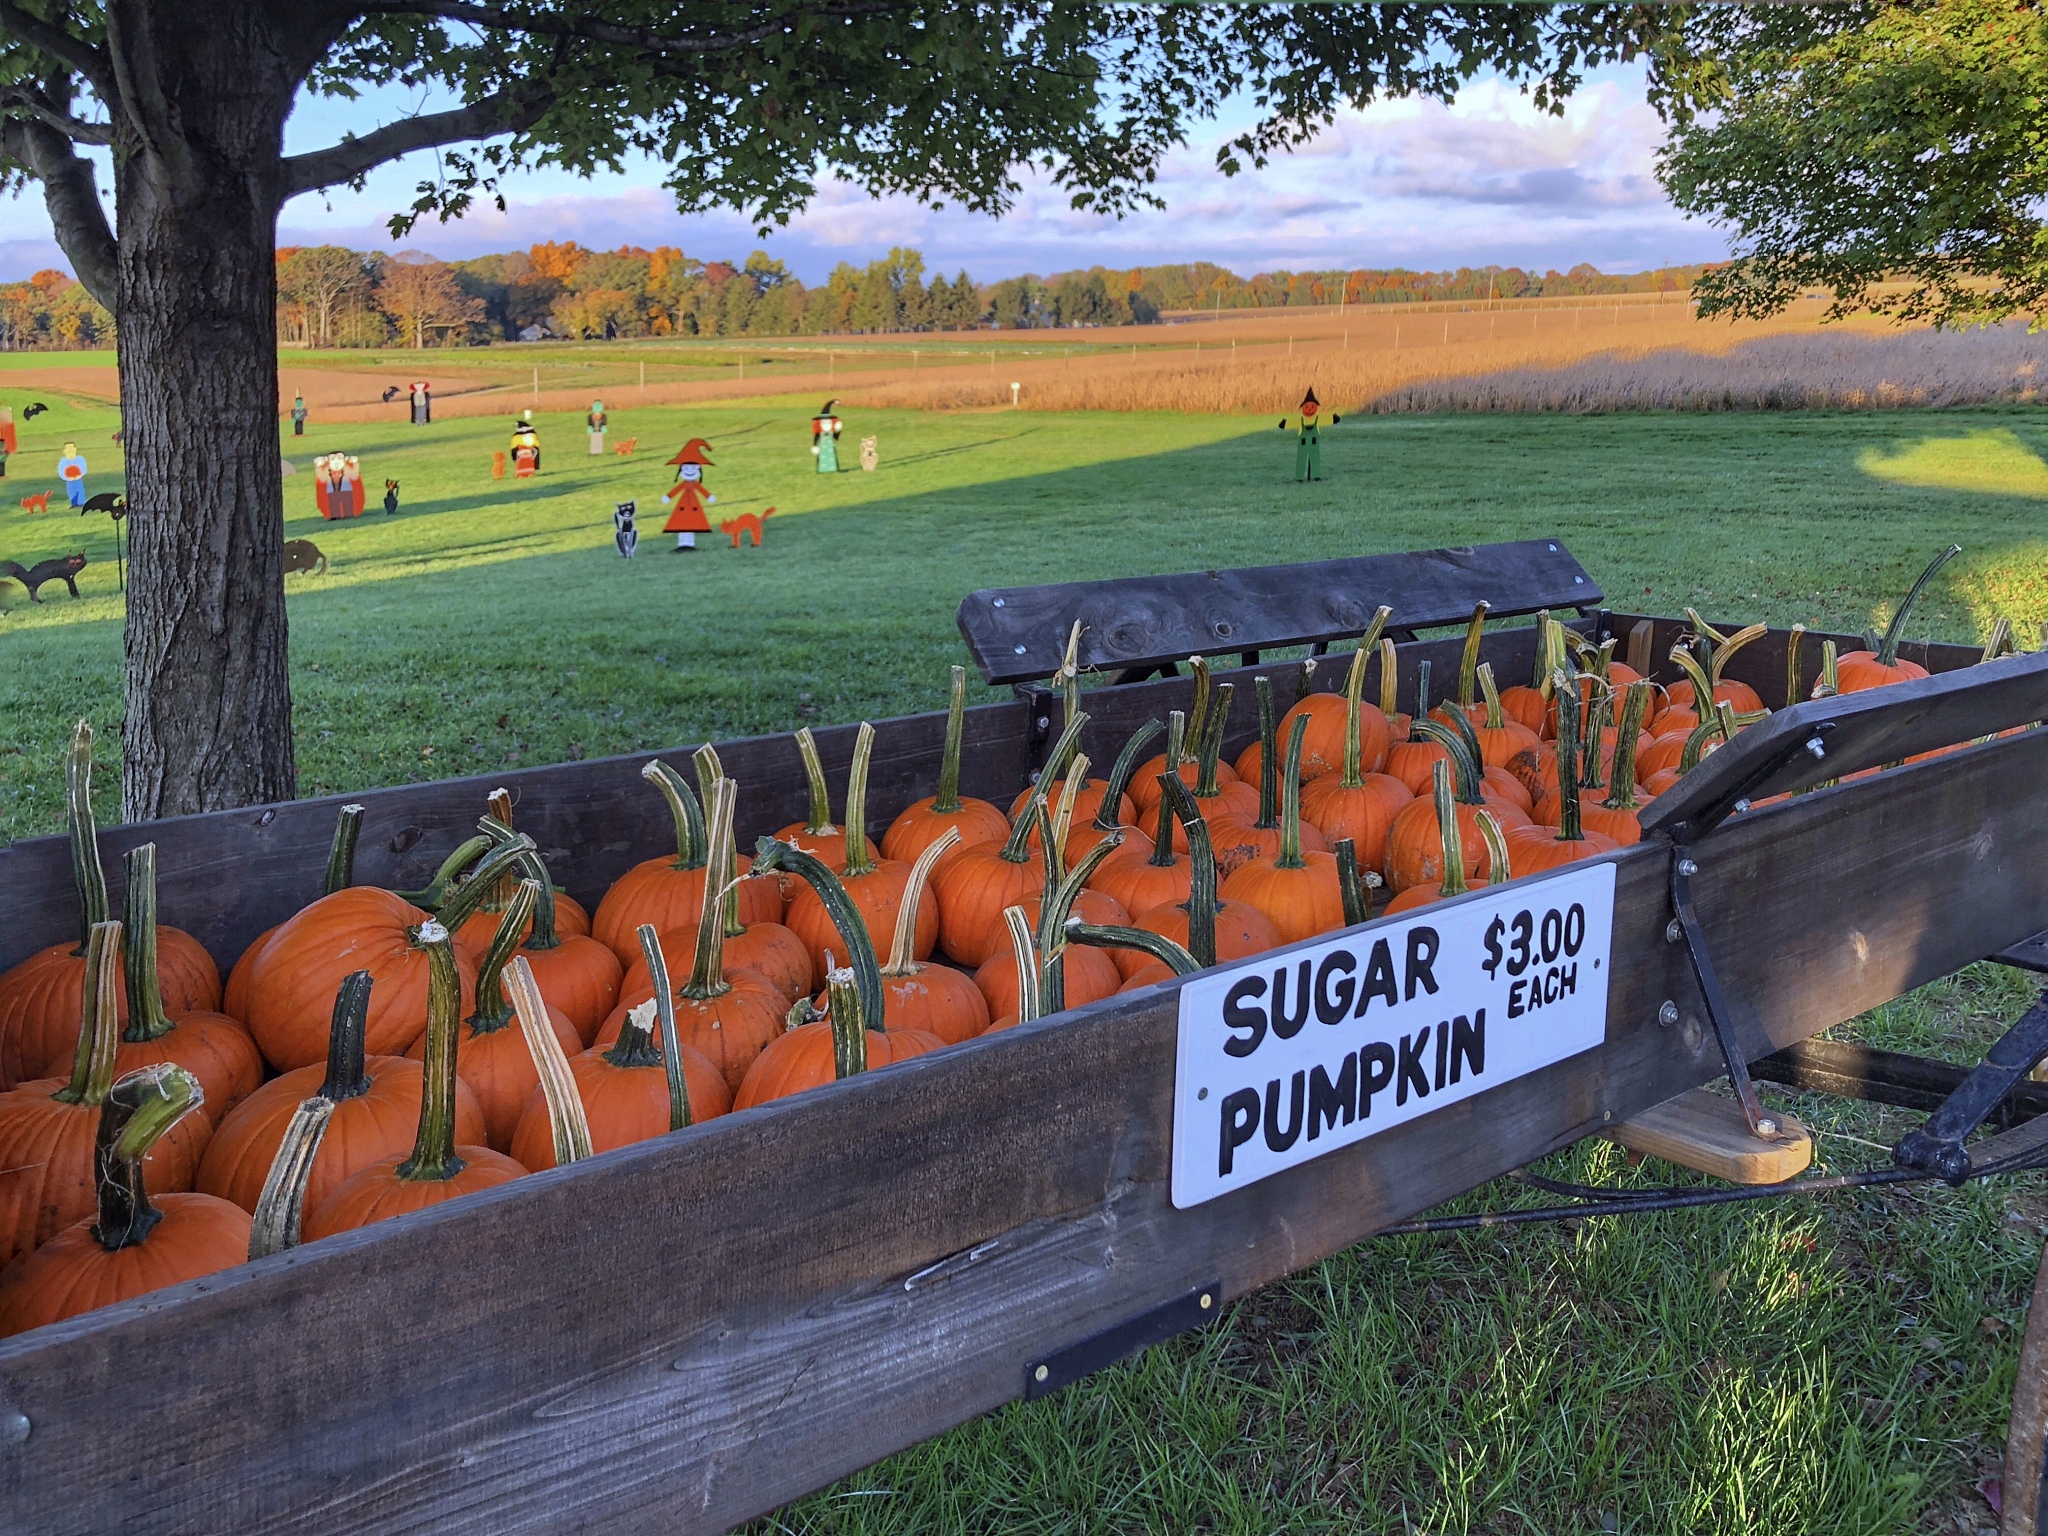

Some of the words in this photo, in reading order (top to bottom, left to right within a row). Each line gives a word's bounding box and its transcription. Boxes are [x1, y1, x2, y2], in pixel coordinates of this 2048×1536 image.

[1223, 926, 1441, 1059] SUGAR
[1481, 902, 1586, 982] $3.00
[1507, 961, 1578, 1020] EACH
[1218, 1007, 1487, 1179] PUMPKIN
